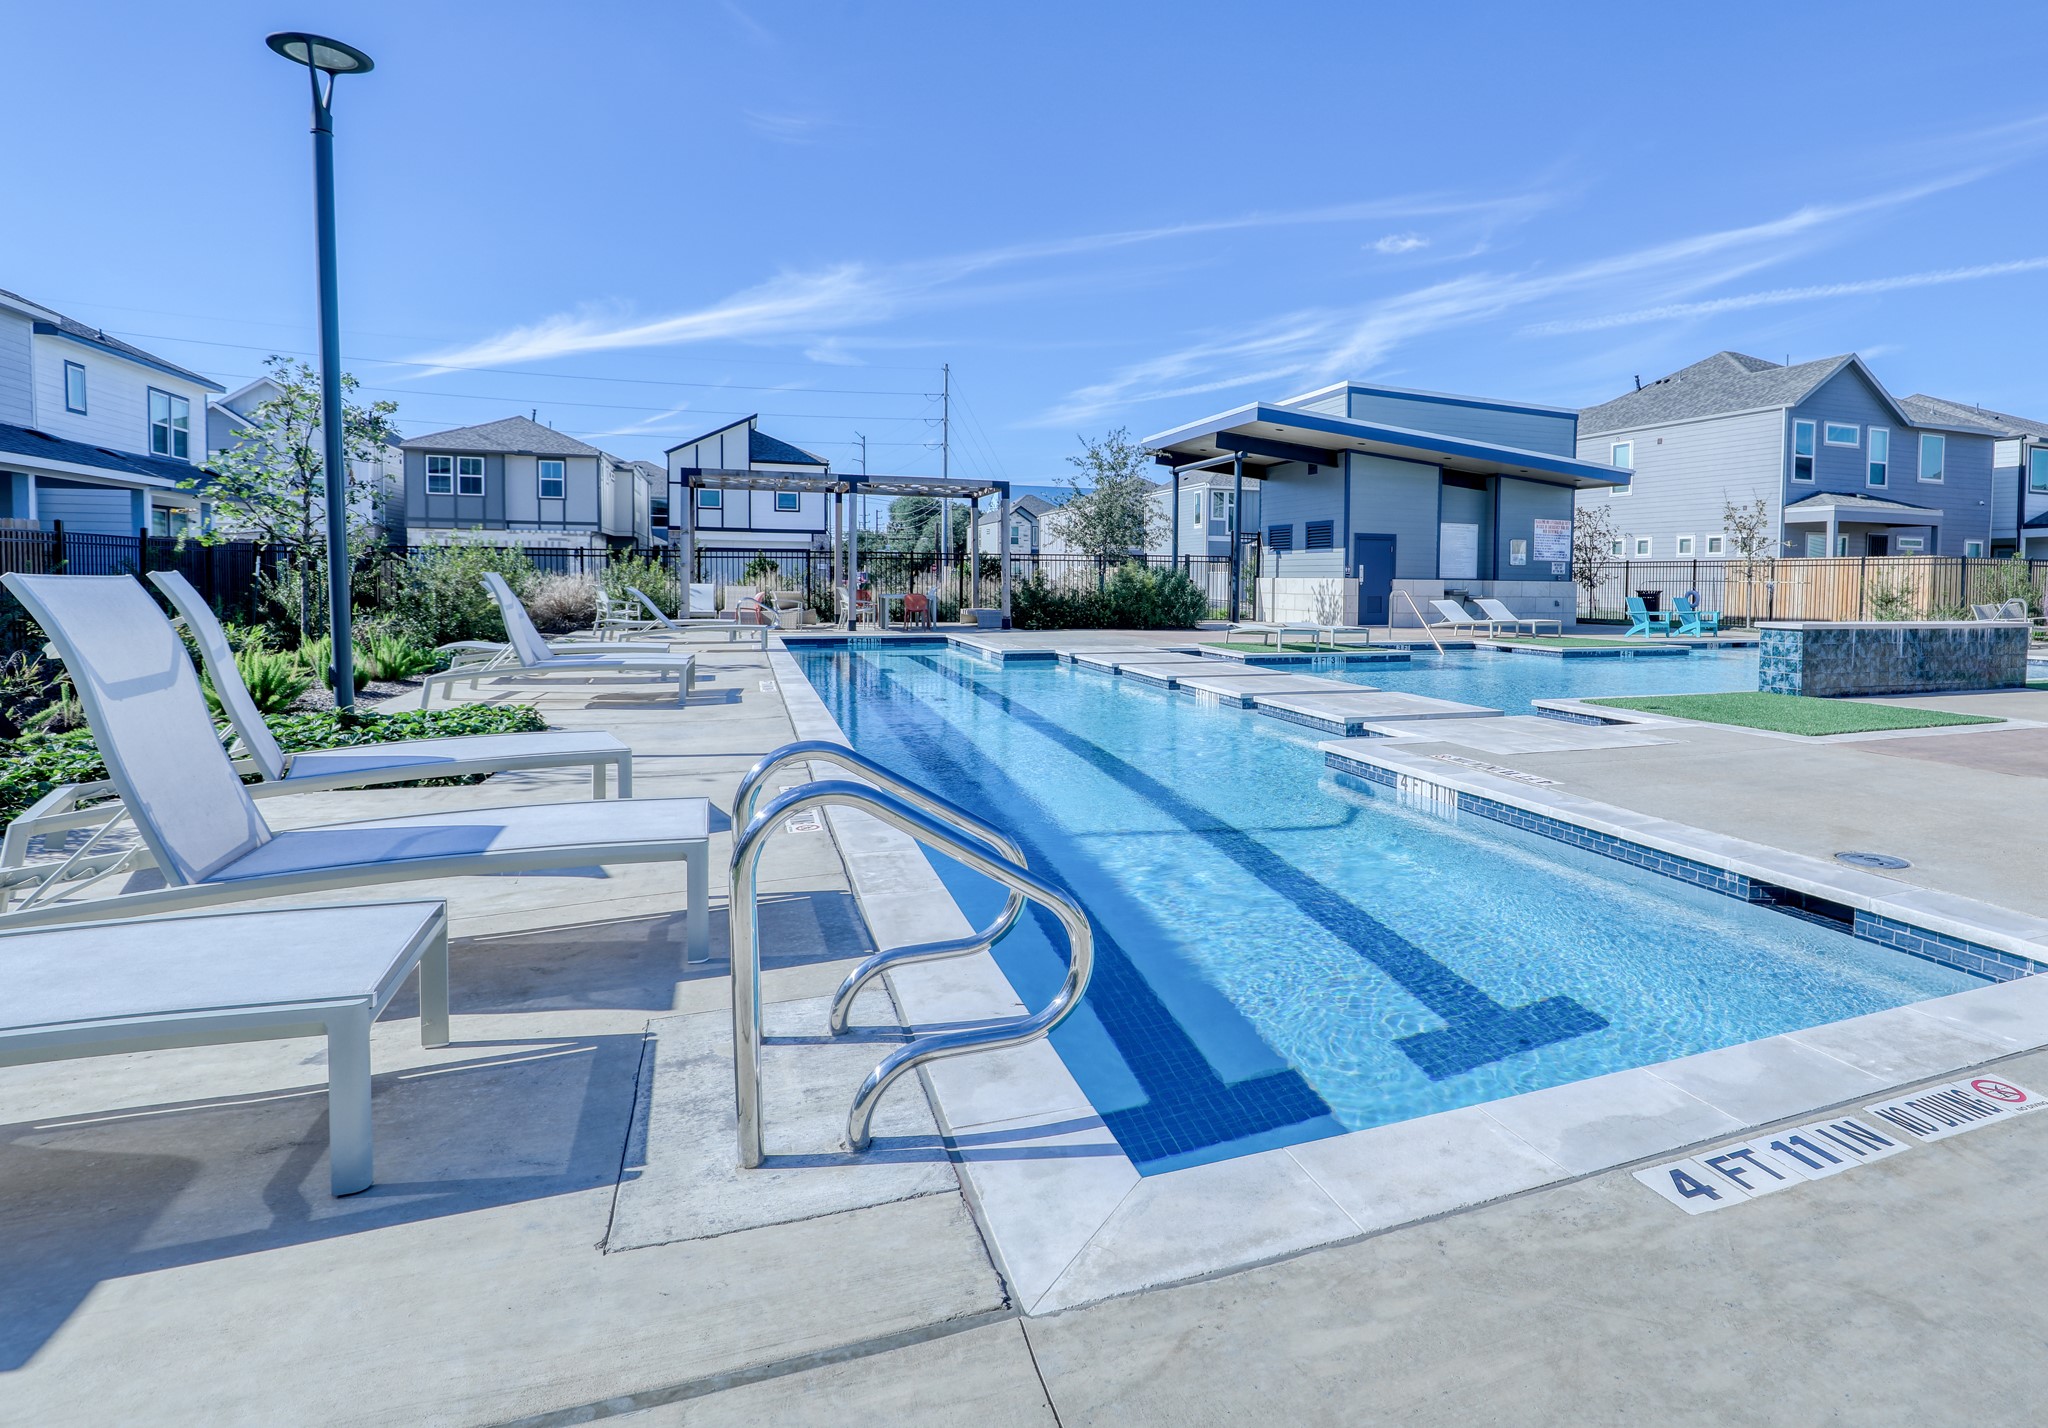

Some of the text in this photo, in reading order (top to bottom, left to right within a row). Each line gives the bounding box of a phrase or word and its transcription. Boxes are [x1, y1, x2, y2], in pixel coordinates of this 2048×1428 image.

[1401, 774, 1456, 806] 4 FT 11 IN
[1874, 1089, 2004, 1137] NO DIVING
[1669, 1120, 1896, 1201] 4 FT 11 IN
